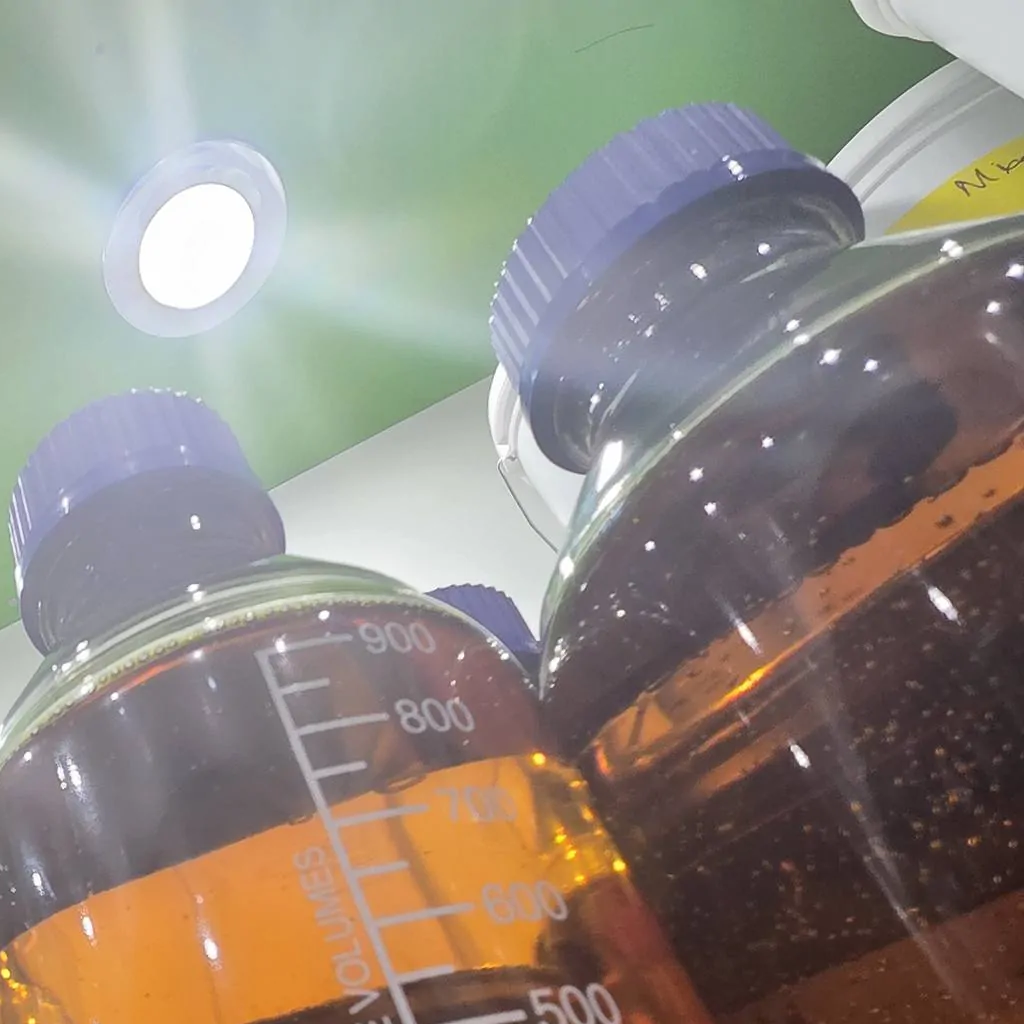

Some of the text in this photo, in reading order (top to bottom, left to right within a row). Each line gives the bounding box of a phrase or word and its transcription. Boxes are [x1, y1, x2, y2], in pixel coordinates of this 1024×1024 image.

[357, 621, 436, 655] 900
[394, 698, 476, 734] 800
[481, 880, 570, 925] 600
[294, 845, 380, 1016] VOLUMES
